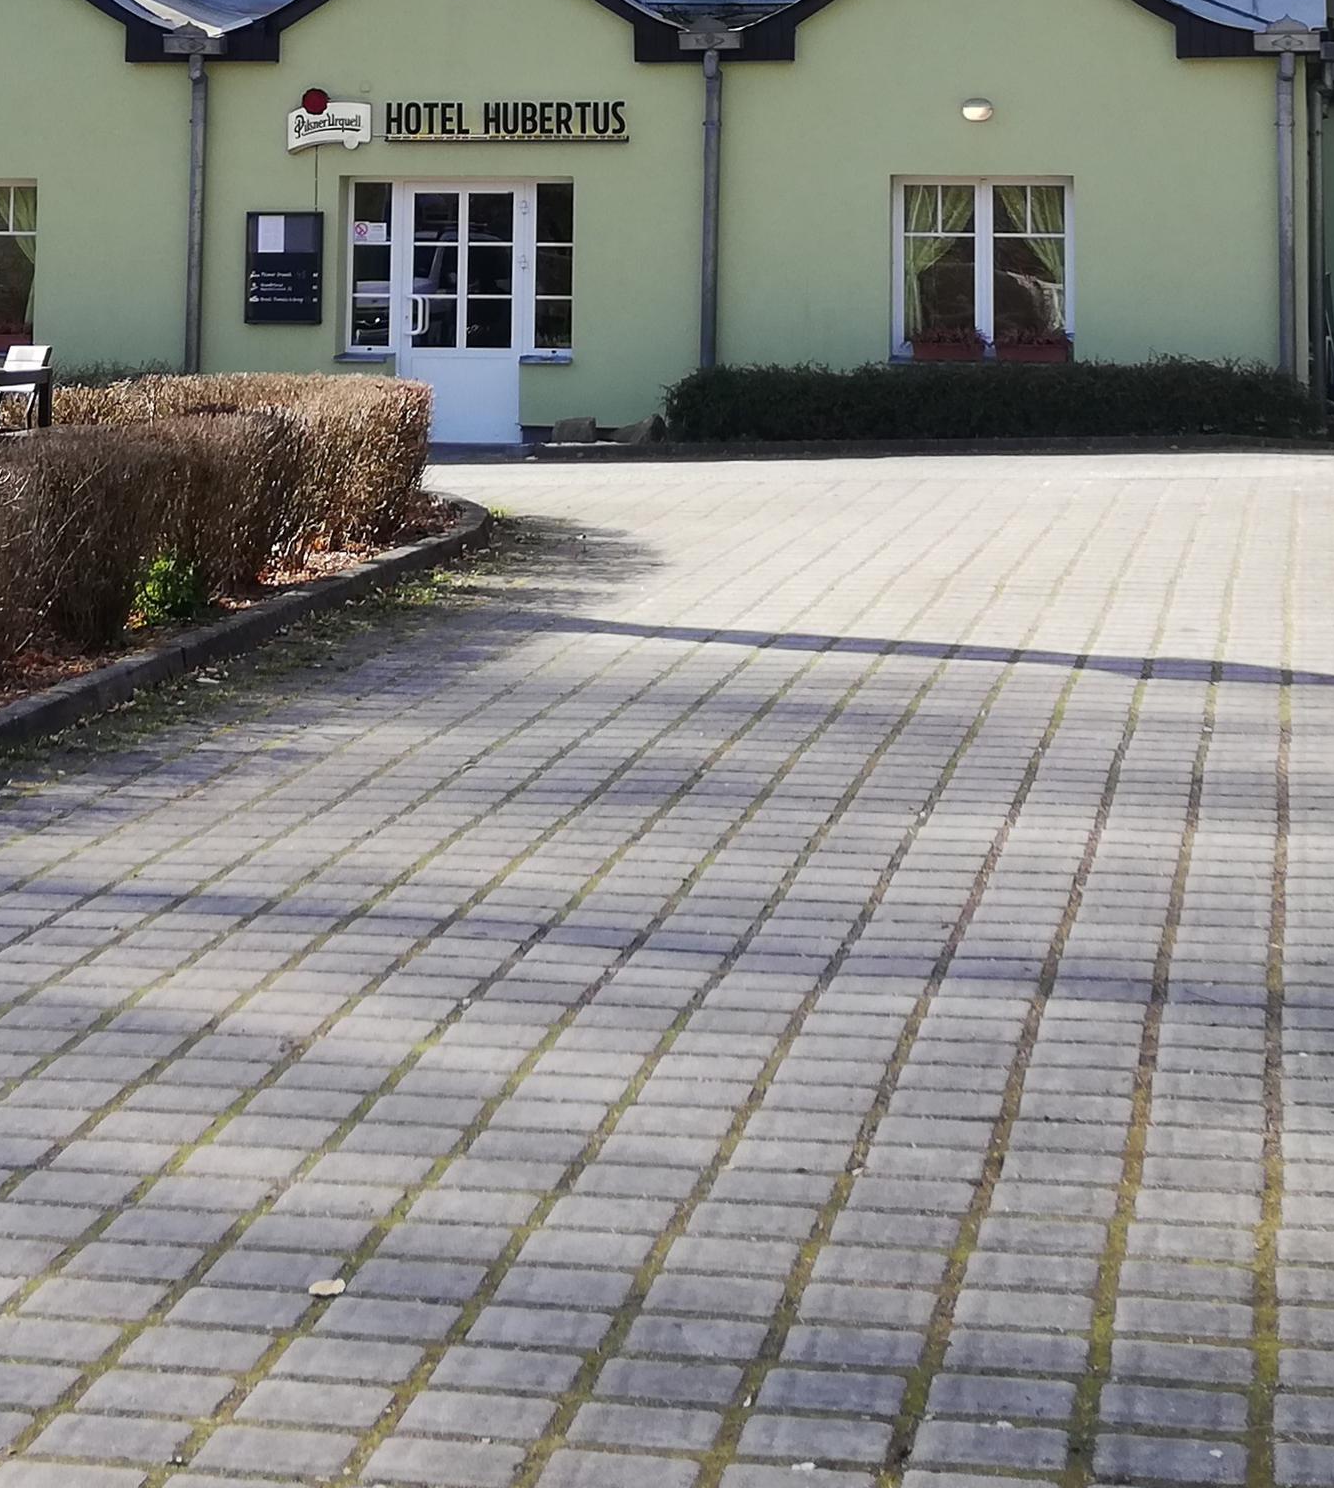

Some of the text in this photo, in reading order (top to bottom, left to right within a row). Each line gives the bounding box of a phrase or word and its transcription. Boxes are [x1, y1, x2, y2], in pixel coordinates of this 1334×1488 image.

[294, 113, 362, 139] Pilsner Urquell
[385, 101, 626, 135] HOTEL HUBERTUS
